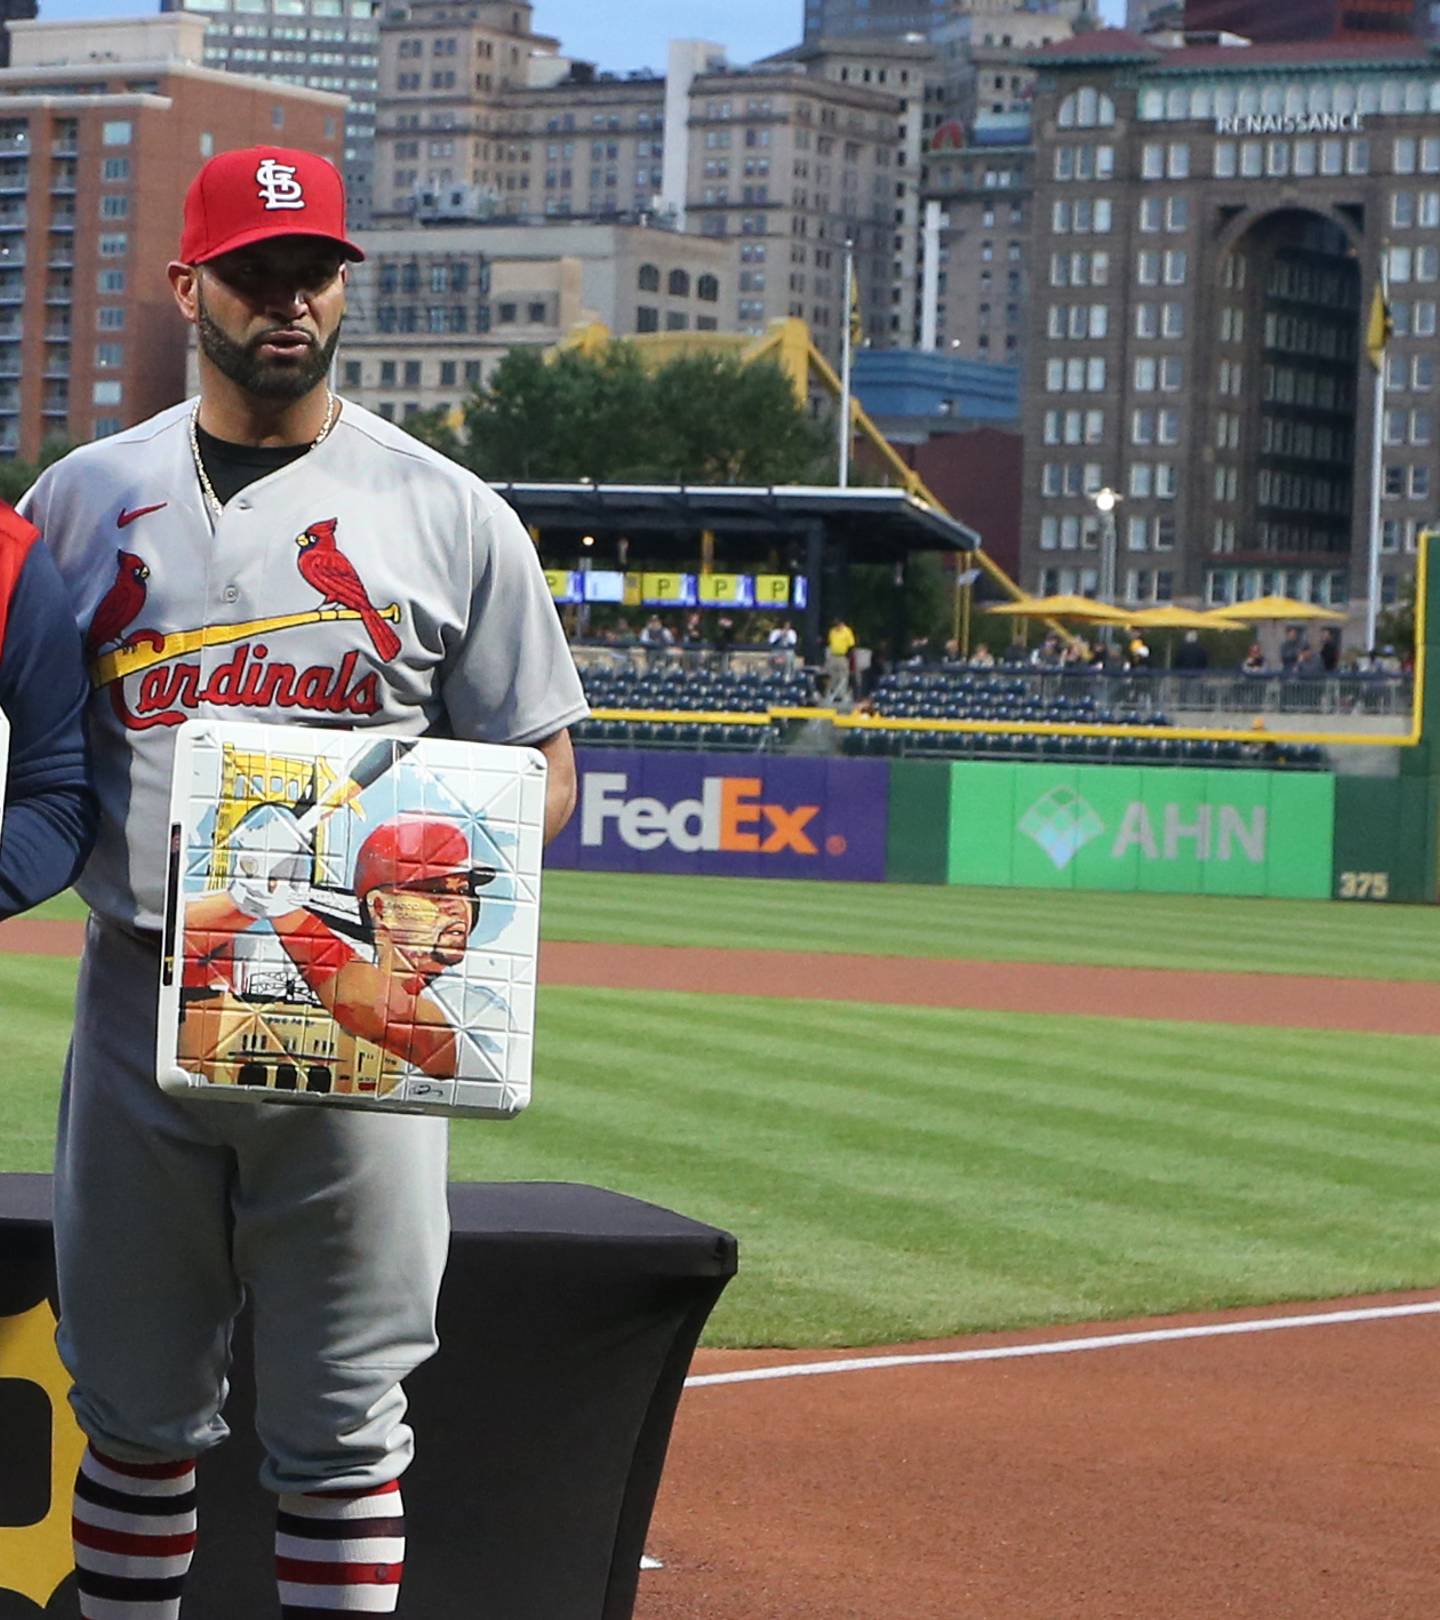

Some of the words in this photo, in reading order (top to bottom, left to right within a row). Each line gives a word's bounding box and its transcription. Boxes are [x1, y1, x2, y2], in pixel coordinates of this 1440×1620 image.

[1215, 112, 1364, 135] RENAISSANCE
[113, 628, 383, 731] Cardinals
[580, 771, 821, 855] FedEx
[1111, 800, 1266, 863] AHN
[1340, 872, 1389, 898] 375
